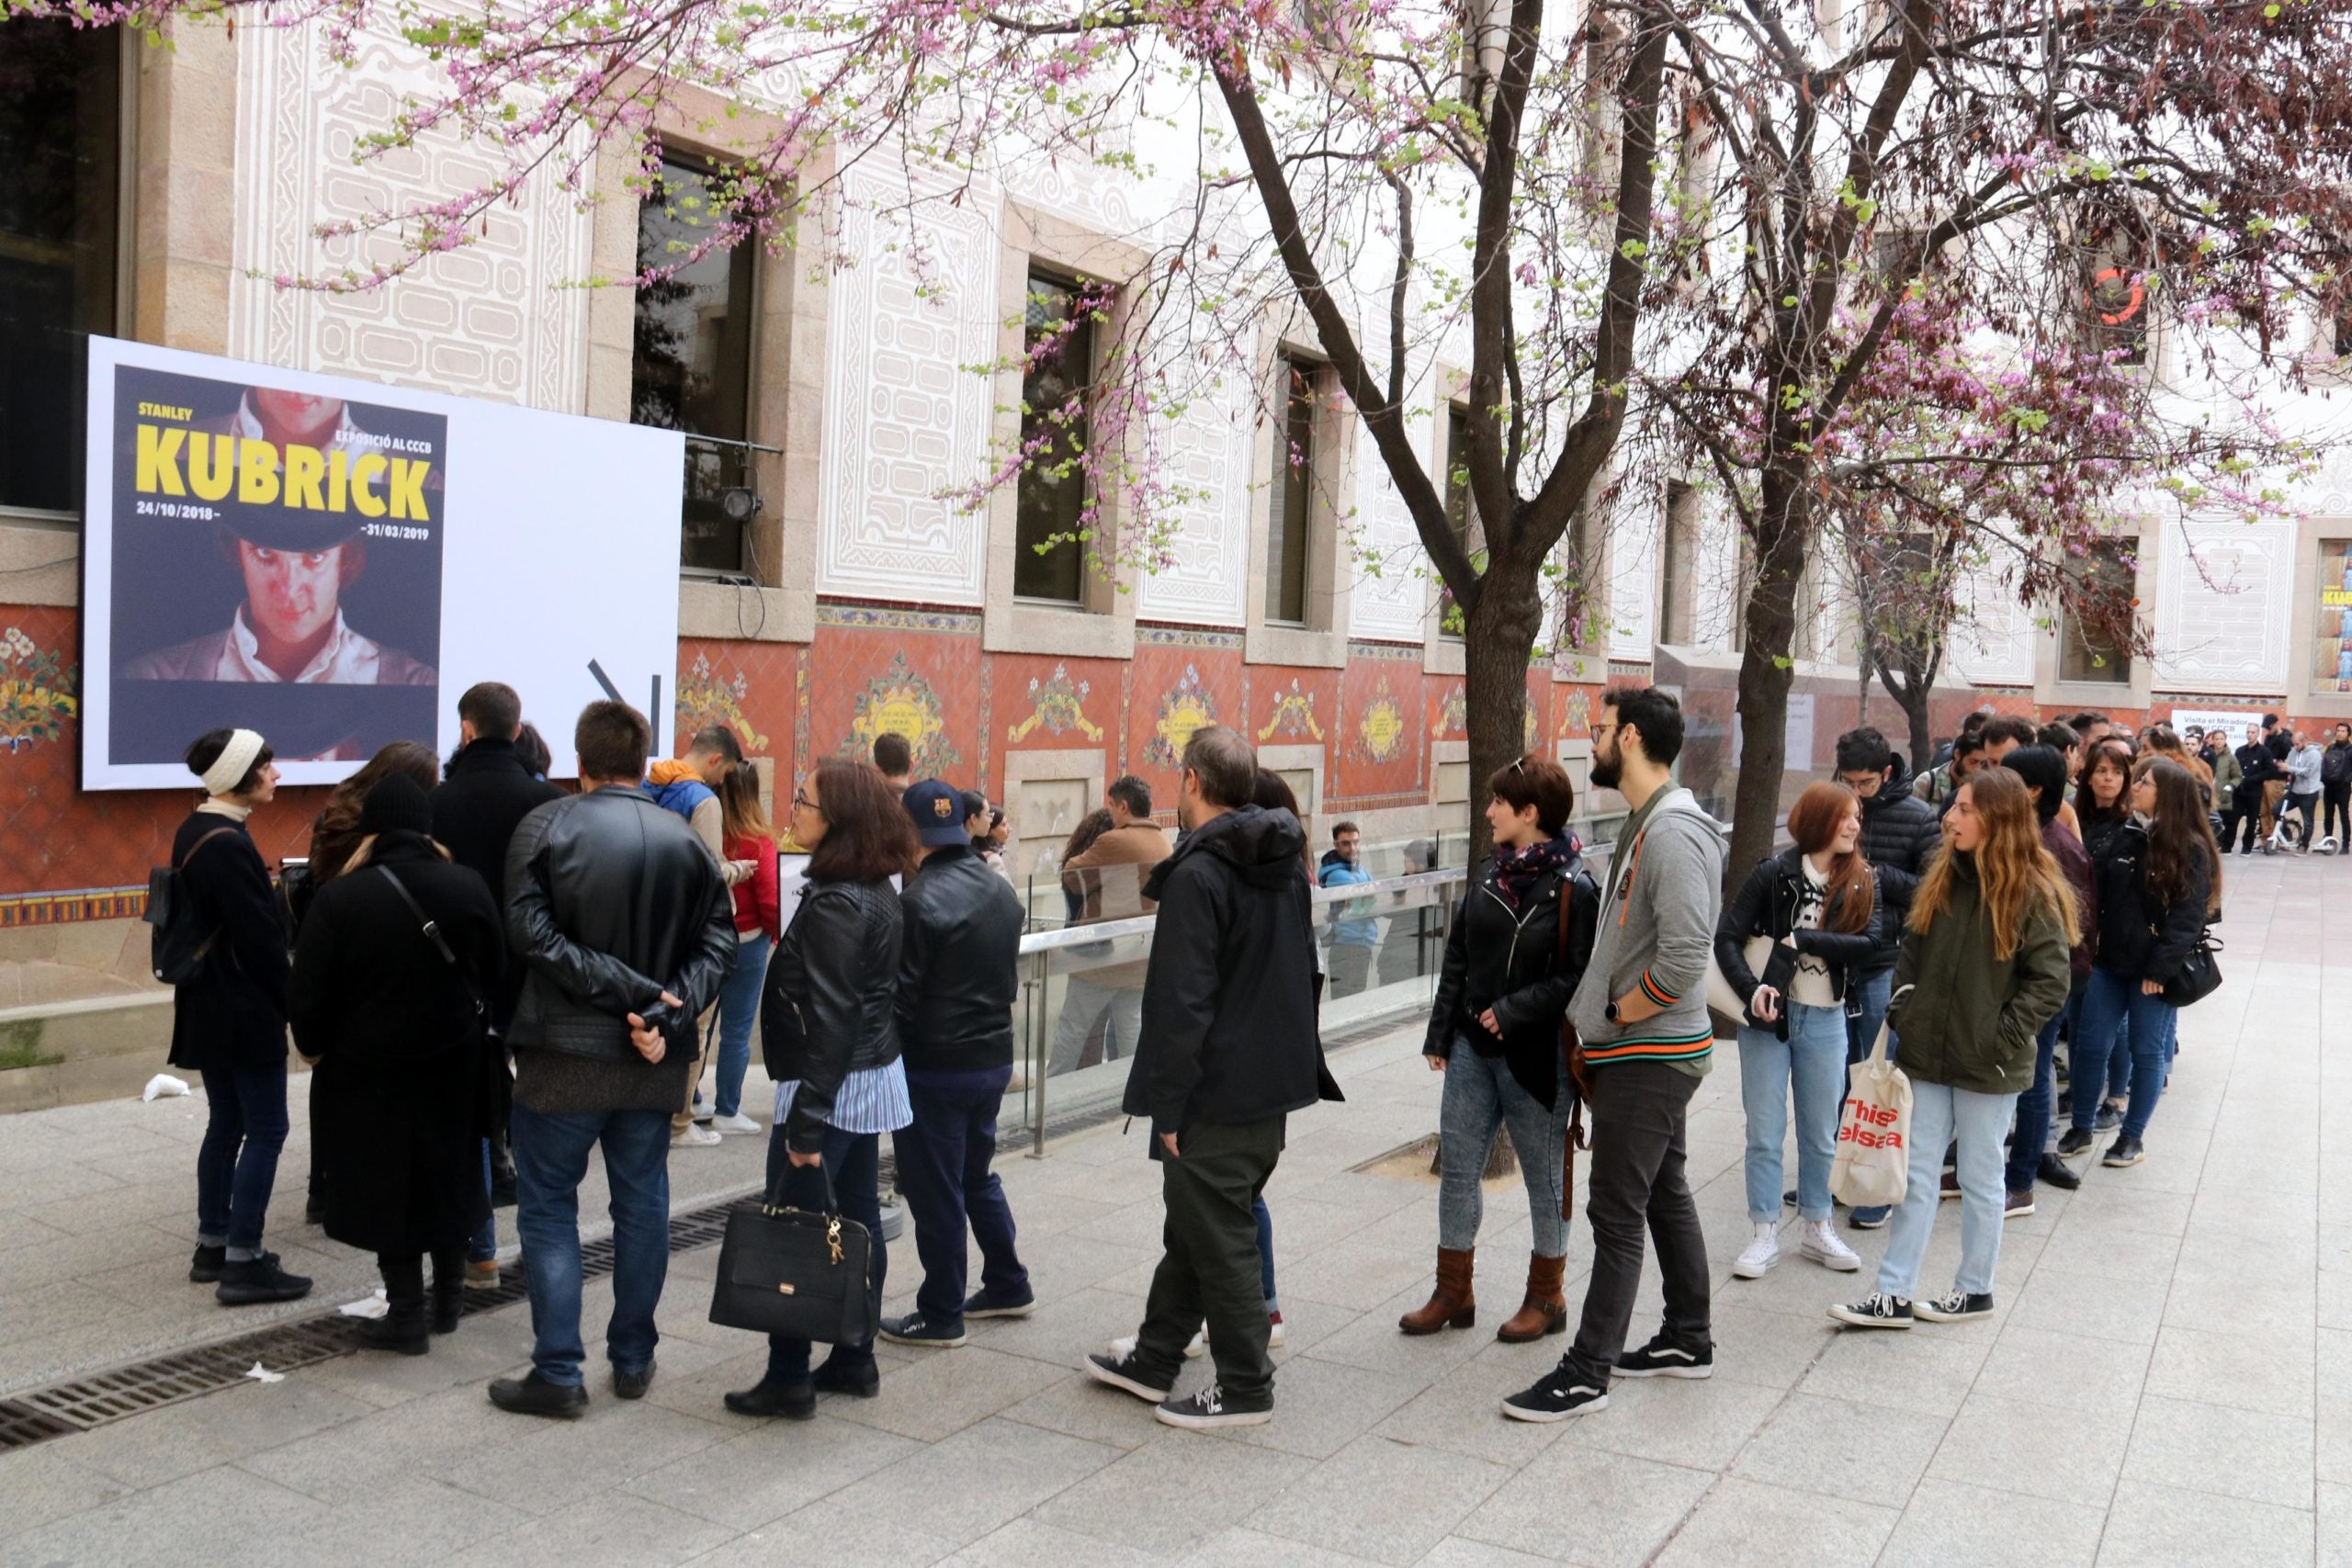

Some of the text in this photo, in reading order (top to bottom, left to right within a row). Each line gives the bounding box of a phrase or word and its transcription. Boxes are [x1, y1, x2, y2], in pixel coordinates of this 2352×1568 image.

[139, 401, 193, 422] STANLEY
[334, 429, 433, 455] EXPOSICIÓ AL CCCB
[136, 423, 431, 522] KUBRICK
[2184, 716, 2207, 725] Visita
[1846, 1098, 1898, 1127] This
